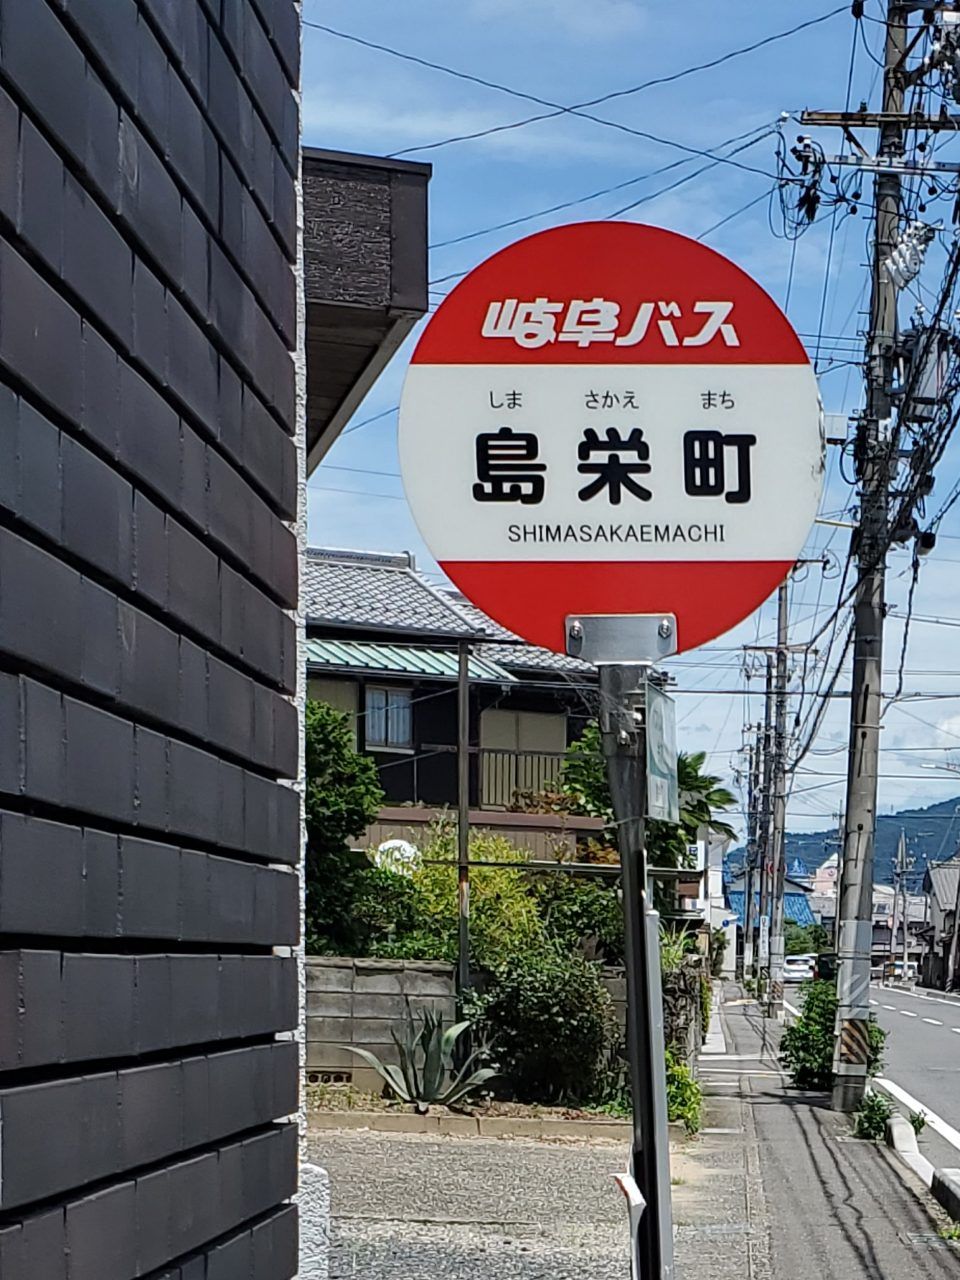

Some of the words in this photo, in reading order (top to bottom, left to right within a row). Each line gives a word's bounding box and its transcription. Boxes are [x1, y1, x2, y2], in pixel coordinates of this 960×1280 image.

[482, 298, 739, 348] 岐阜バス
[490, 390, 522, 409] しま
[585, 390, 639, 409] さかえ
[701, 390, 734, 409] まち
[472, 427, 757, 505] 島栄町
[509, 524, 724, 542] SHIMASAKAEMACHI
